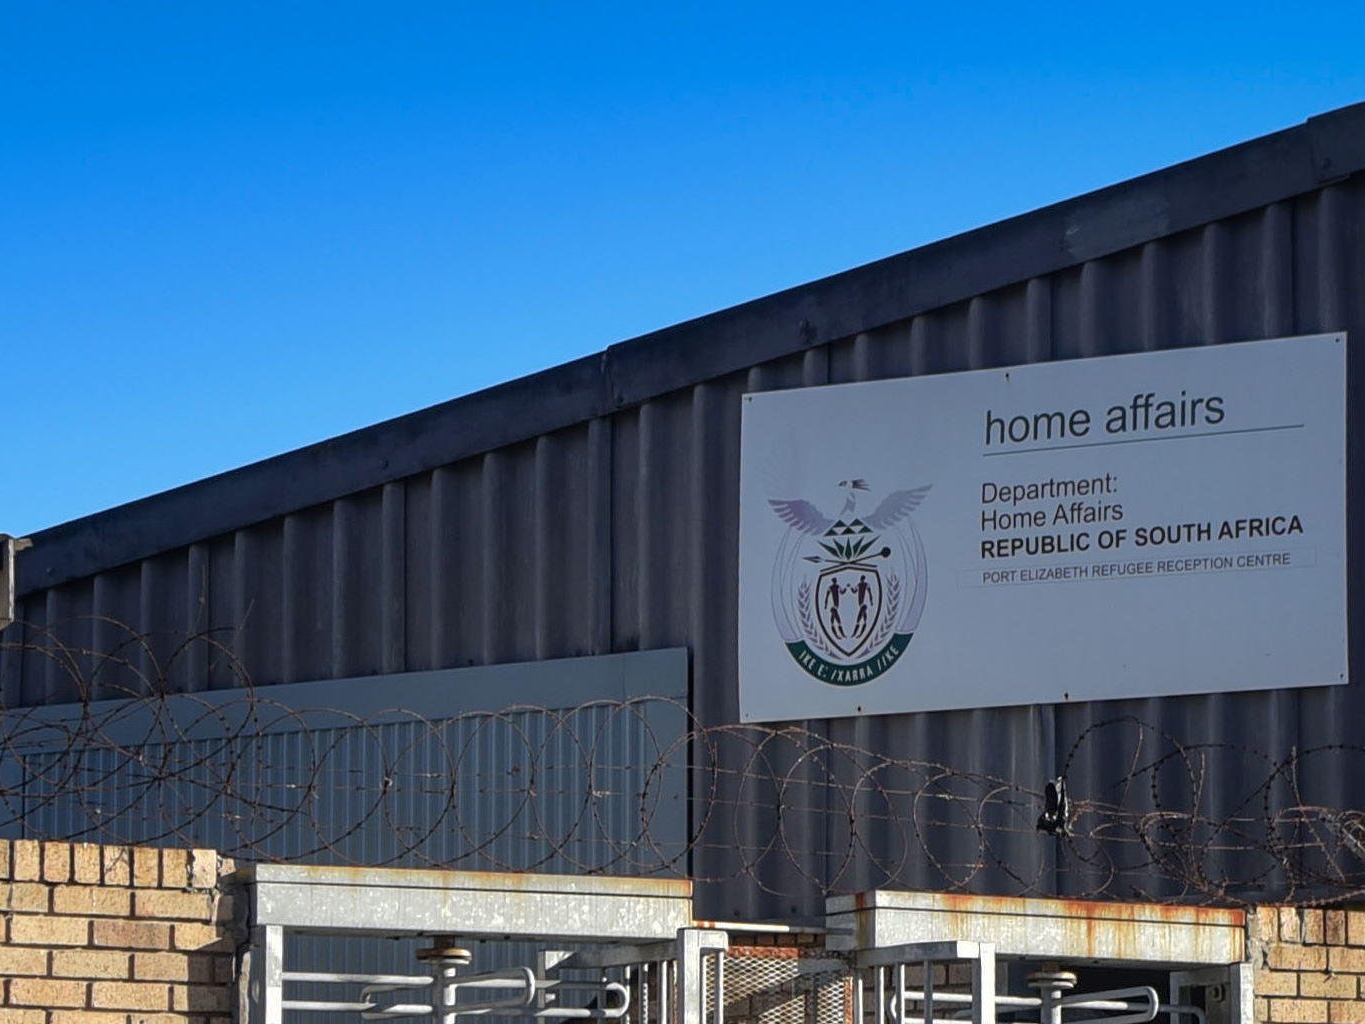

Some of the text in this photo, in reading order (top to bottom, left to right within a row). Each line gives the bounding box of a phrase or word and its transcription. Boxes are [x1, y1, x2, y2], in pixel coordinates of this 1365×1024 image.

[986, 391, 1226, 445] home affairs
[982, 473, 1118, 505] Department:
[982, 501, 1123, 531] Home Affairs
[982, 515, 1303, 559] REPUBLIC OF SOUTH AFRICA
[983, 553, 1290, 583] PORT ELIZABETH REFUGEE RECEPTION CENTRE
